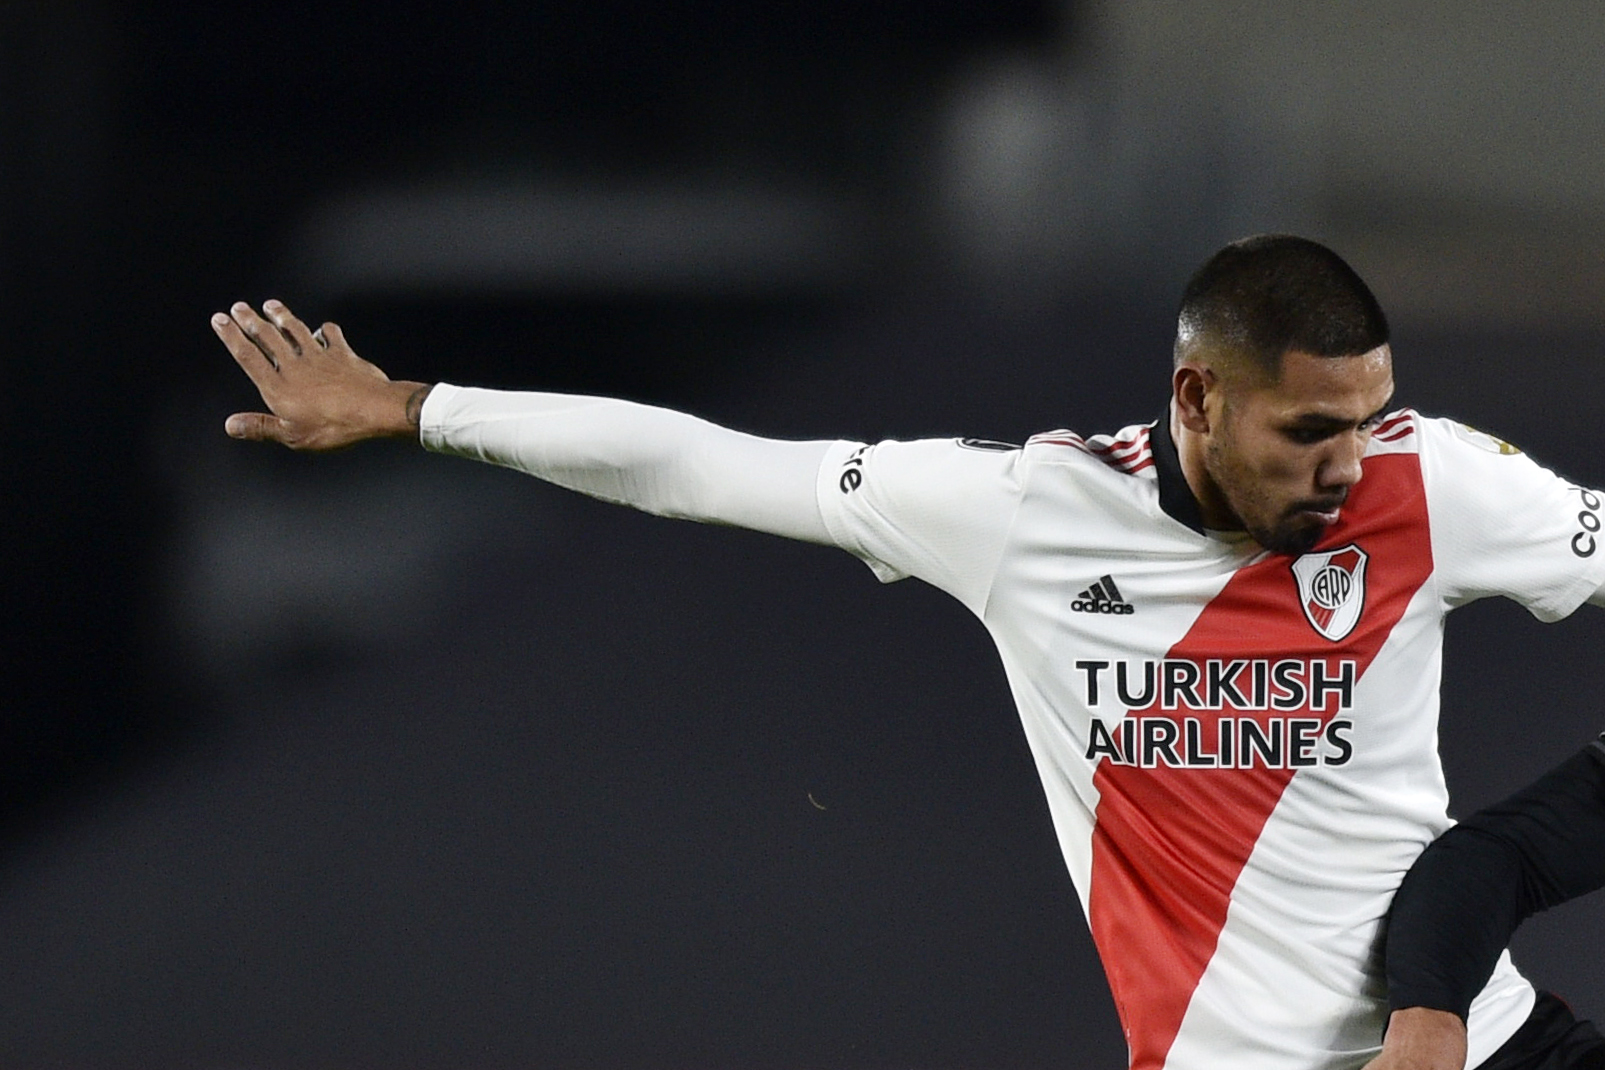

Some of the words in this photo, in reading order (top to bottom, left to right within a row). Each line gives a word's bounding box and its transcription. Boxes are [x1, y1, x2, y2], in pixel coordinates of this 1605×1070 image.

[1070, 598, 1135, 615] adidas
[1074, 659, 1355, 711] TURKISH
[1085, 717, 1355, 768] AIRLINES
